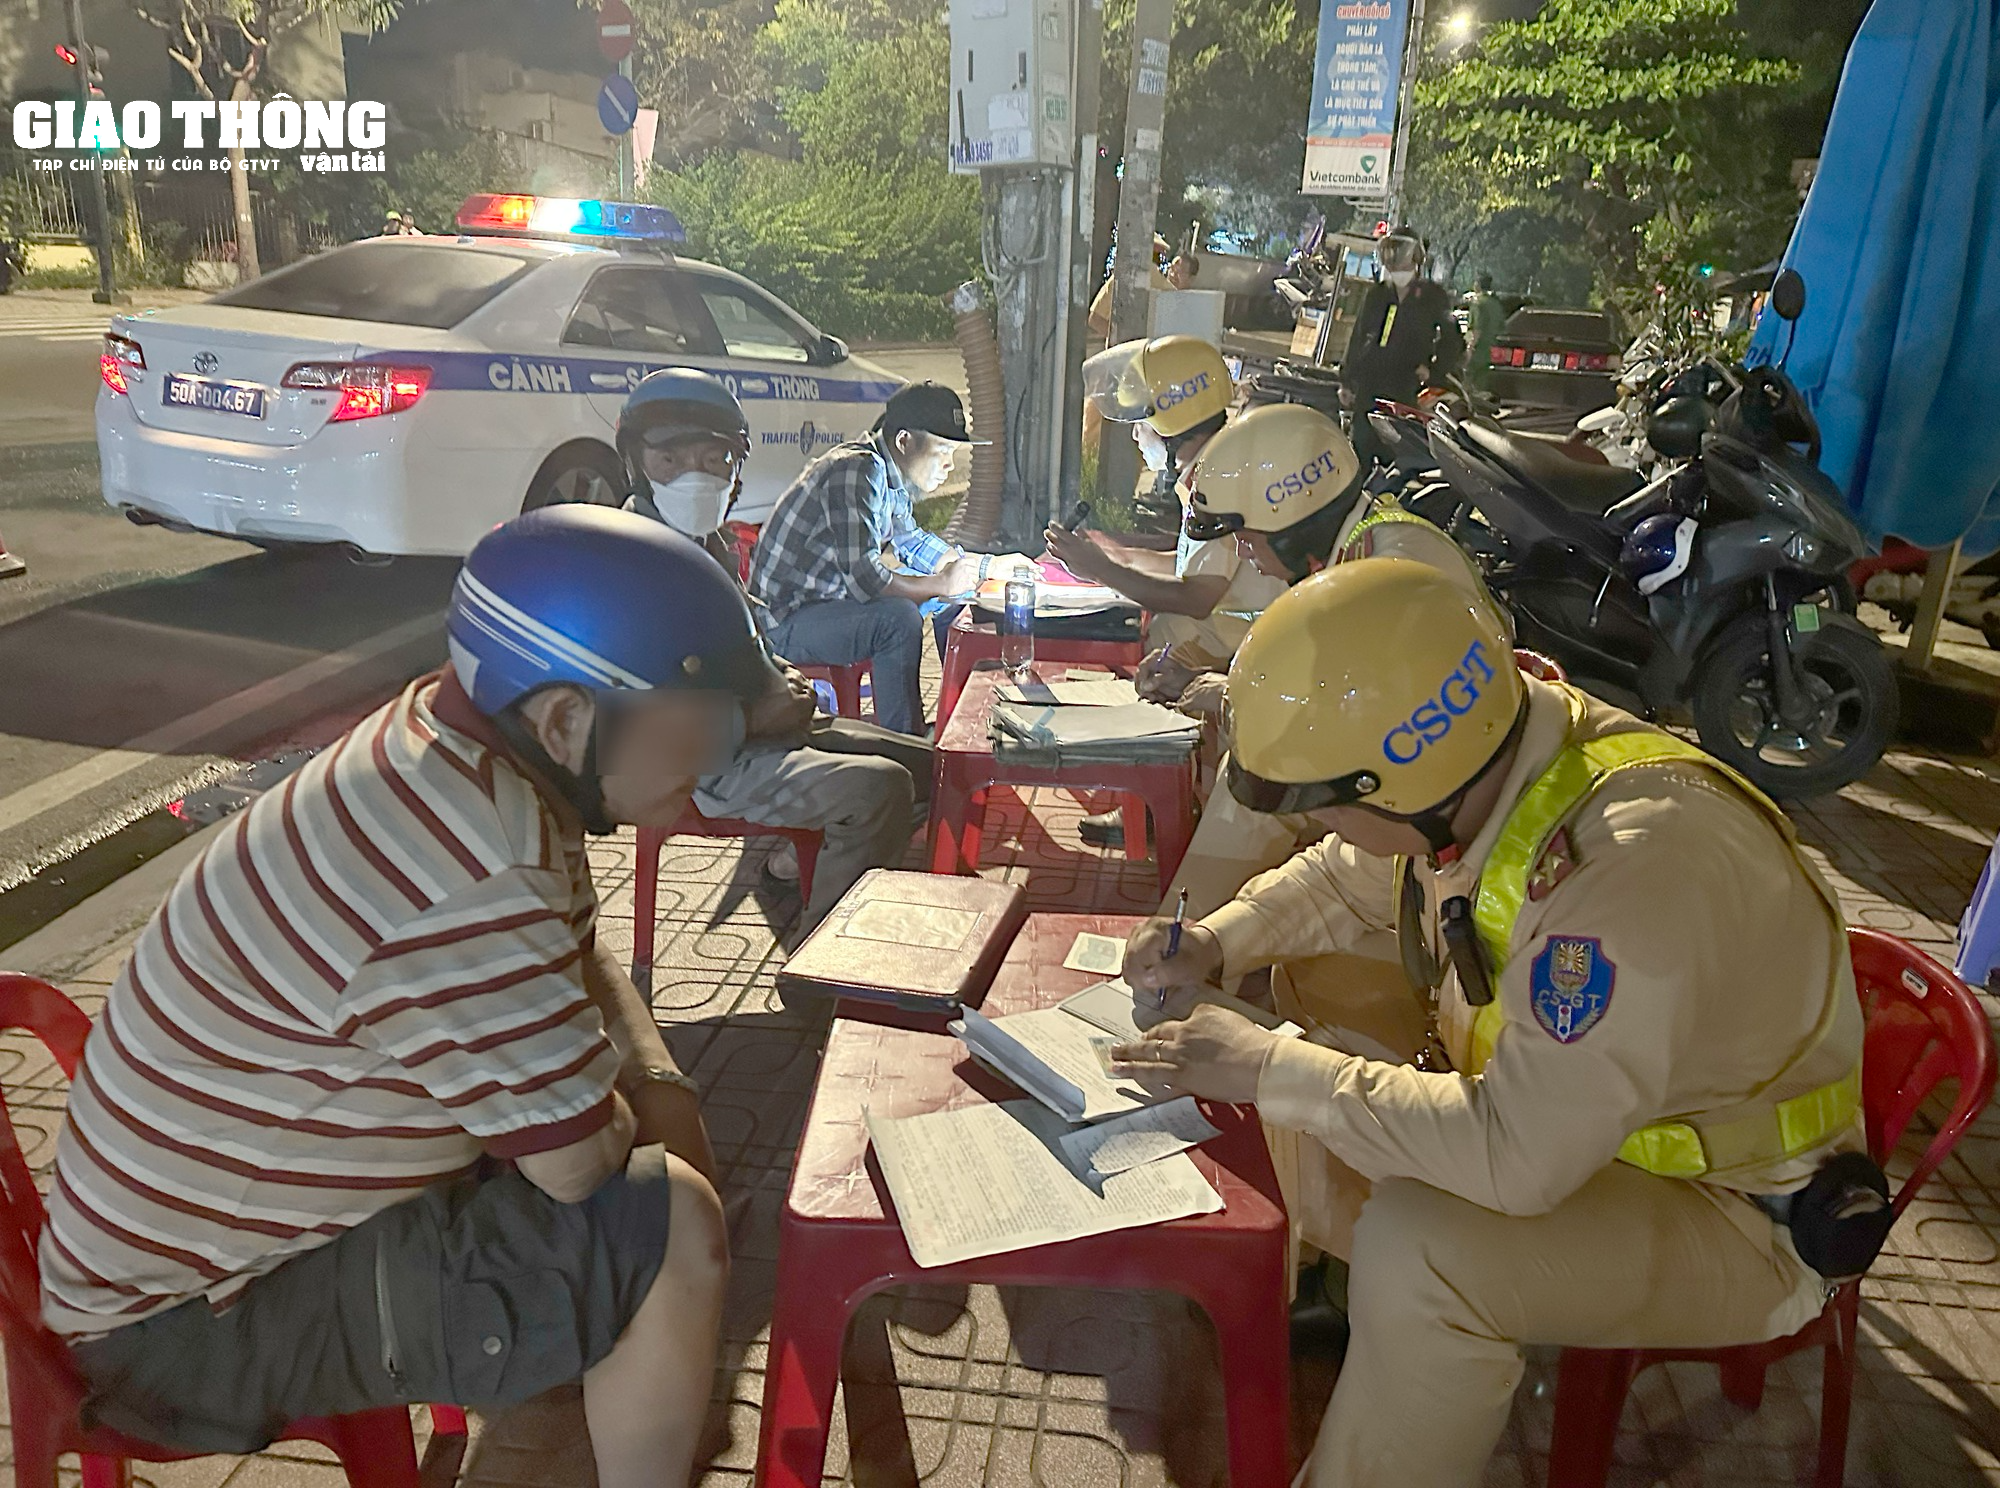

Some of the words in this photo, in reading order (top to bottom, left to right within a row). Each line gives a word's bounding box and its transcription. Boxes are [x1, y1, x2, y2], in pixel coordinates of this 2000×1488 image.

[1310, 170, 1381, 184] Vietcombank
[488, 355, 573, 393] CẢNH
[1155, 372, 1211, 411] CSGT
[761, 432, 800, 444] TRAFFIC
[814, 432, 845, 444] POLICE
[1265, 450, 1337, 505] CSGT
[1383, 638, 1497, 765] CSGT
[1537, 989, 1602, 1009] CSGT
